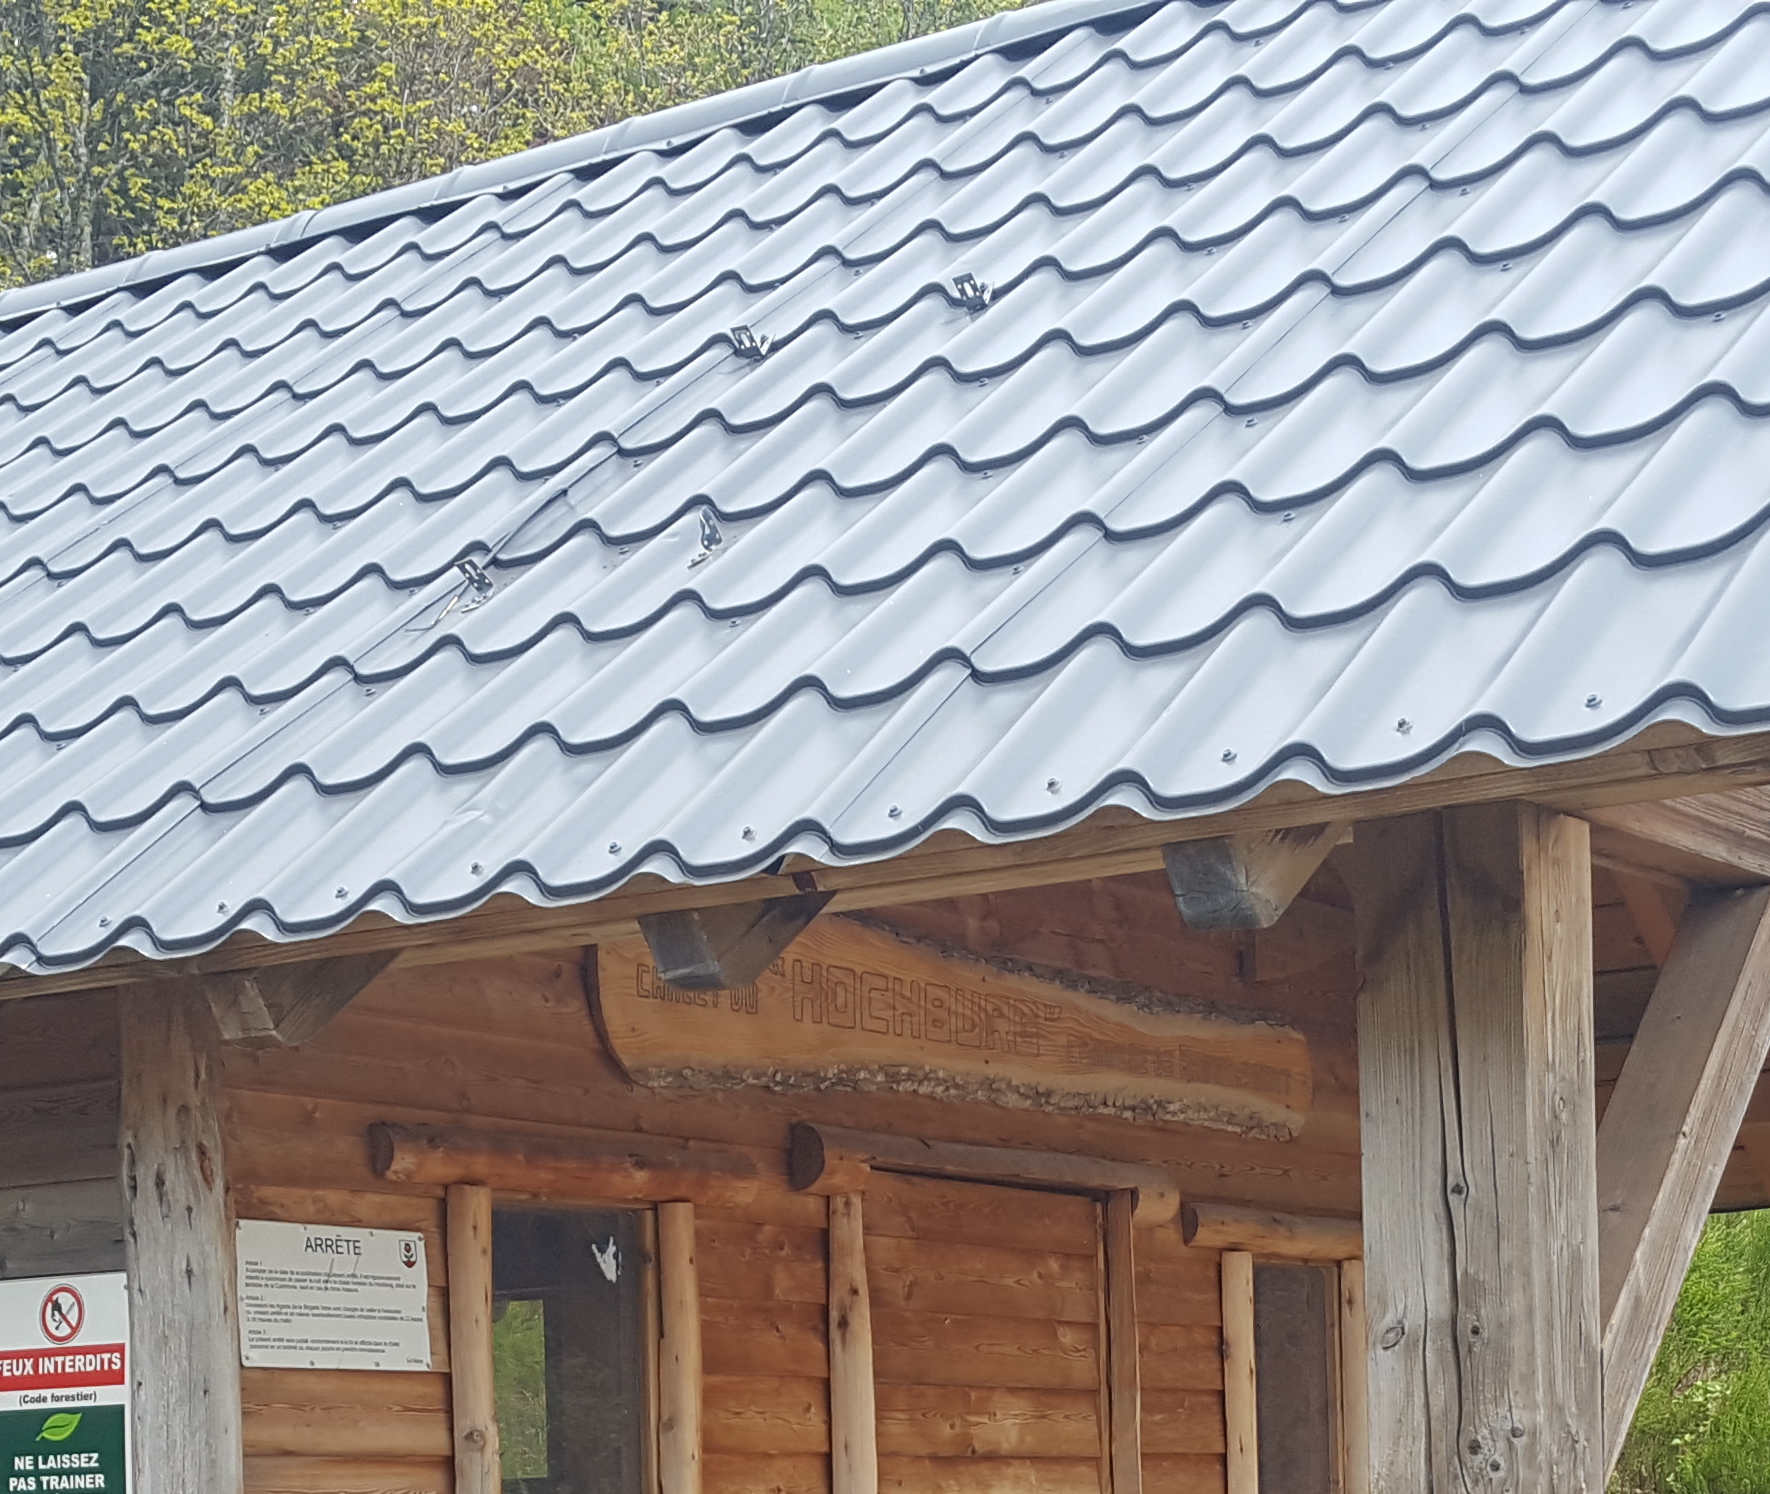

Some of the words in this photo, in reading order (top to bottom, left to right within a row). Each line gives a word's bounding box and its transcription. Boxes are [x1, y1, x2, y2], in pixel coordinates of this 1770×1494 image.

[38, 1352, 122, 1375] INTERDITS
[19, 1393, 48, 1407] (Code
[50, 1390, 97, 1404] forestier)
[14, 1455, 35, 1471] NE
[37, 1452, 99, 1470] LAISSEZ
[8, 1476, 37, 1492] PAS
[40, 1473, 105, 1491] TRAINER
